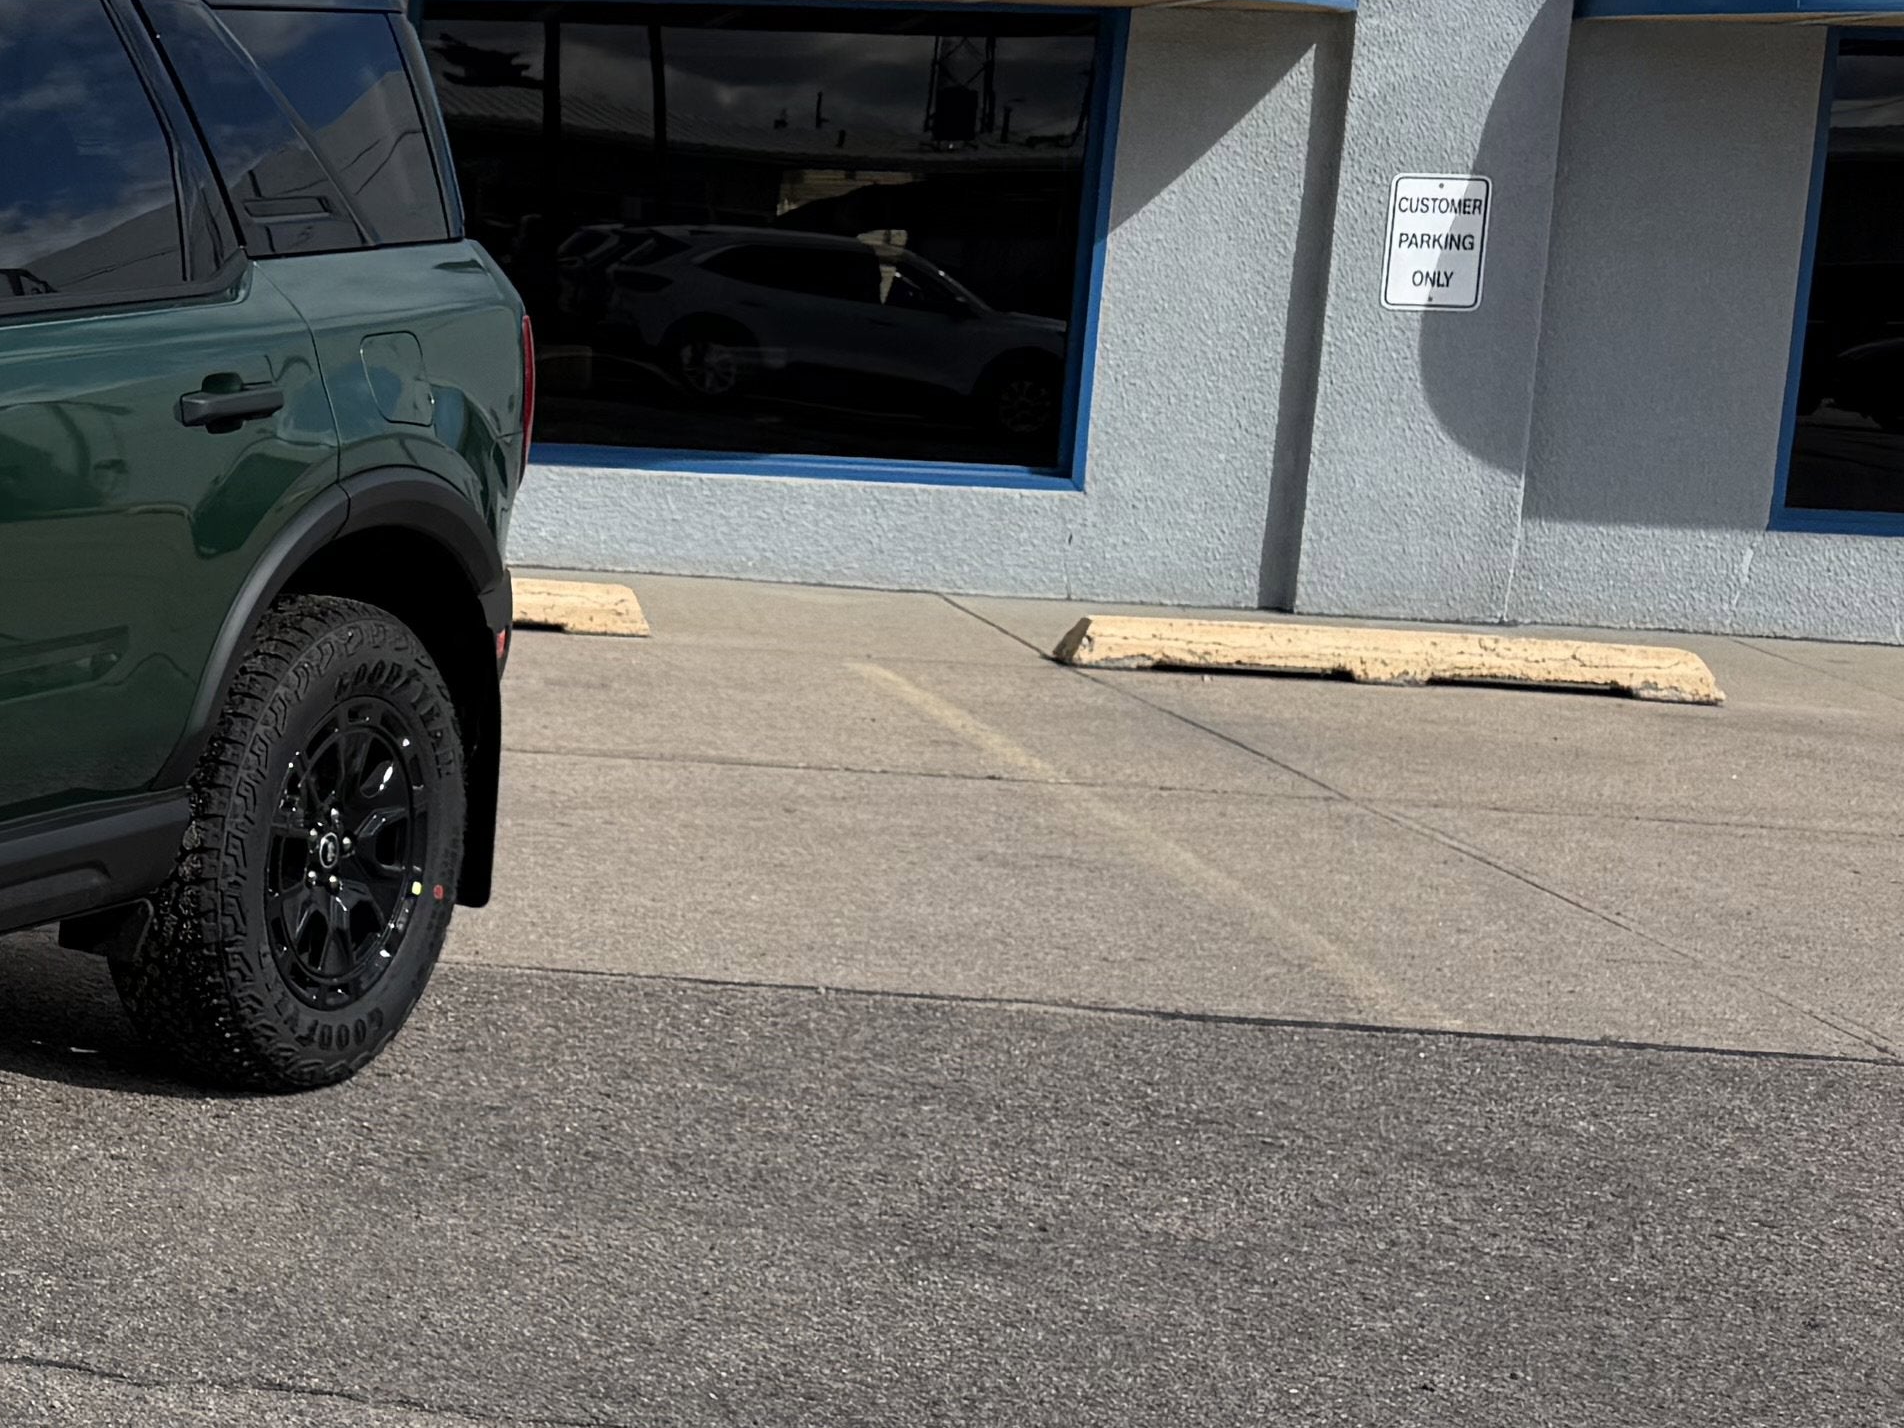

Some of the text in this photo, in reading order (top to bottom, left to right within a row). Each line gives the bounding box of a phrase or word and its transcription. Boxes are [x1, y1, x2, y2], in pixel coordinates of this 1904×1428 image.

[1398, 196, 1483, 215] CUSTOMER
[1398, 232, 1475, 251] PARKING
[1411, 270, 1454, 287] ONLY
